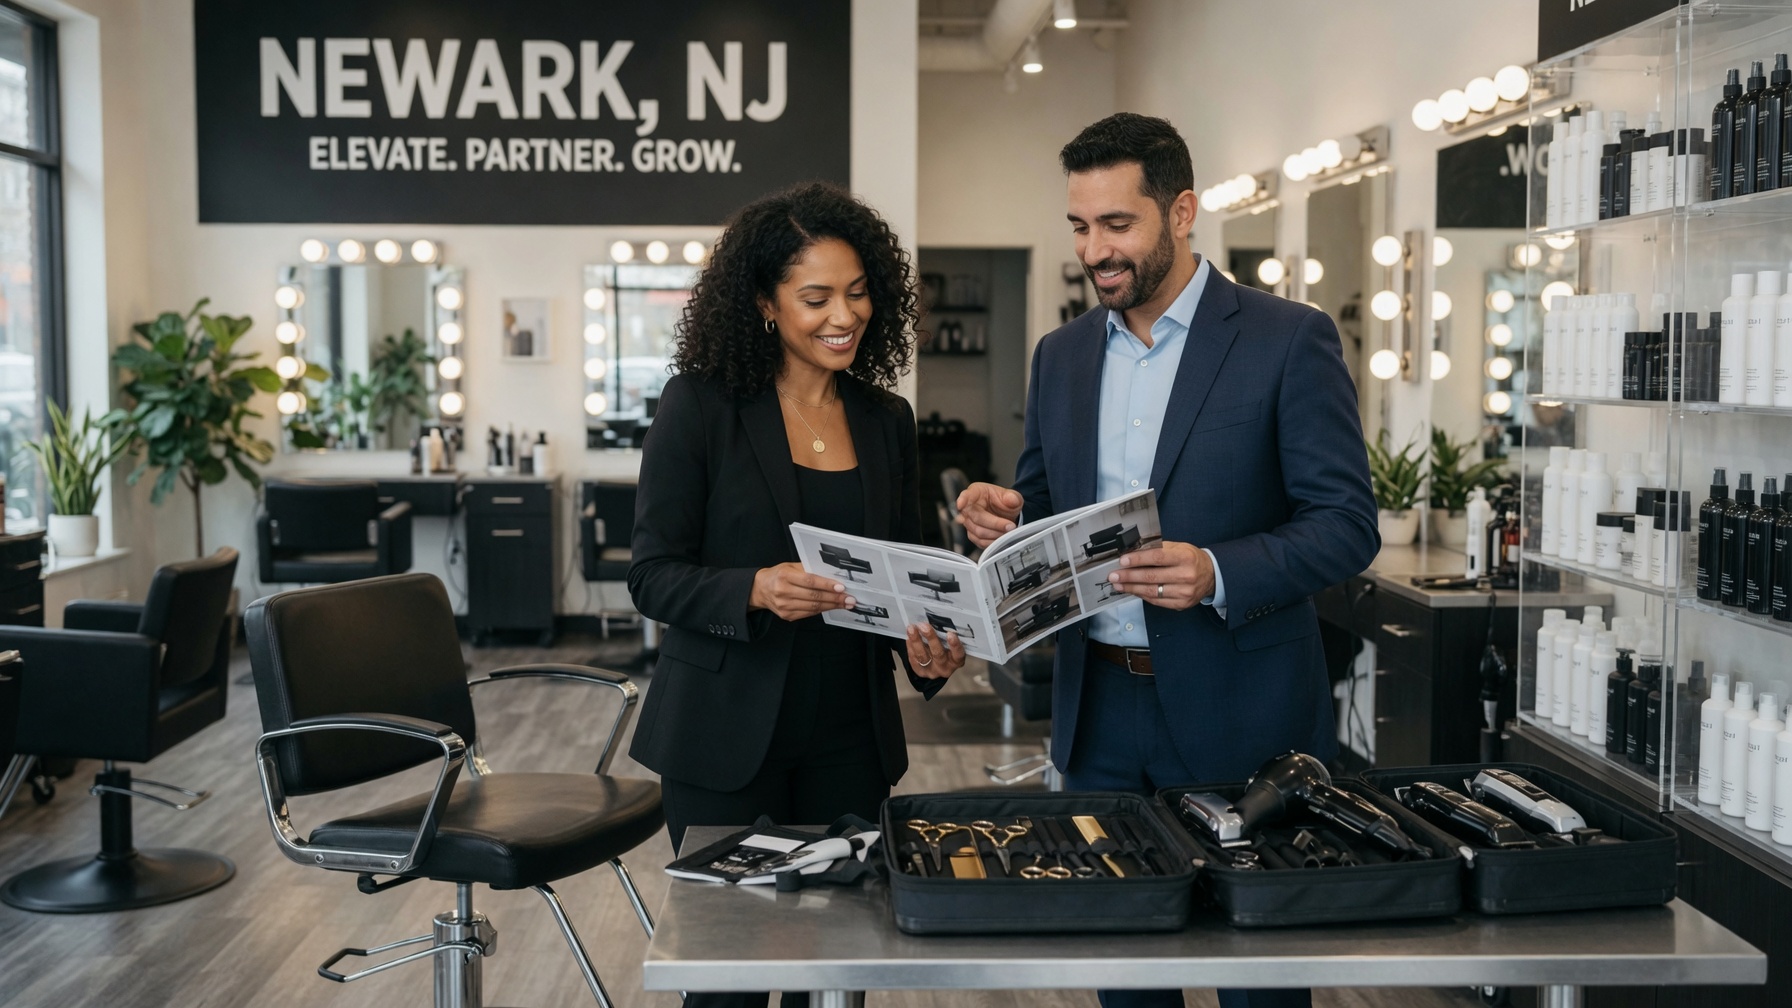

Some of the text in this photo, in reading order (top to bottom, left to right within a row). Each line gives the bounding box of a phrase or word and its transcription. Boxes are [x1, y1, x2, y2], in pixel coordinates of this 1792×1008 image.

[260, 38, 787, 136] NEWARK, NJ
[309, 137, 742, 173] ELEVATE. PARTNER. GROW.
